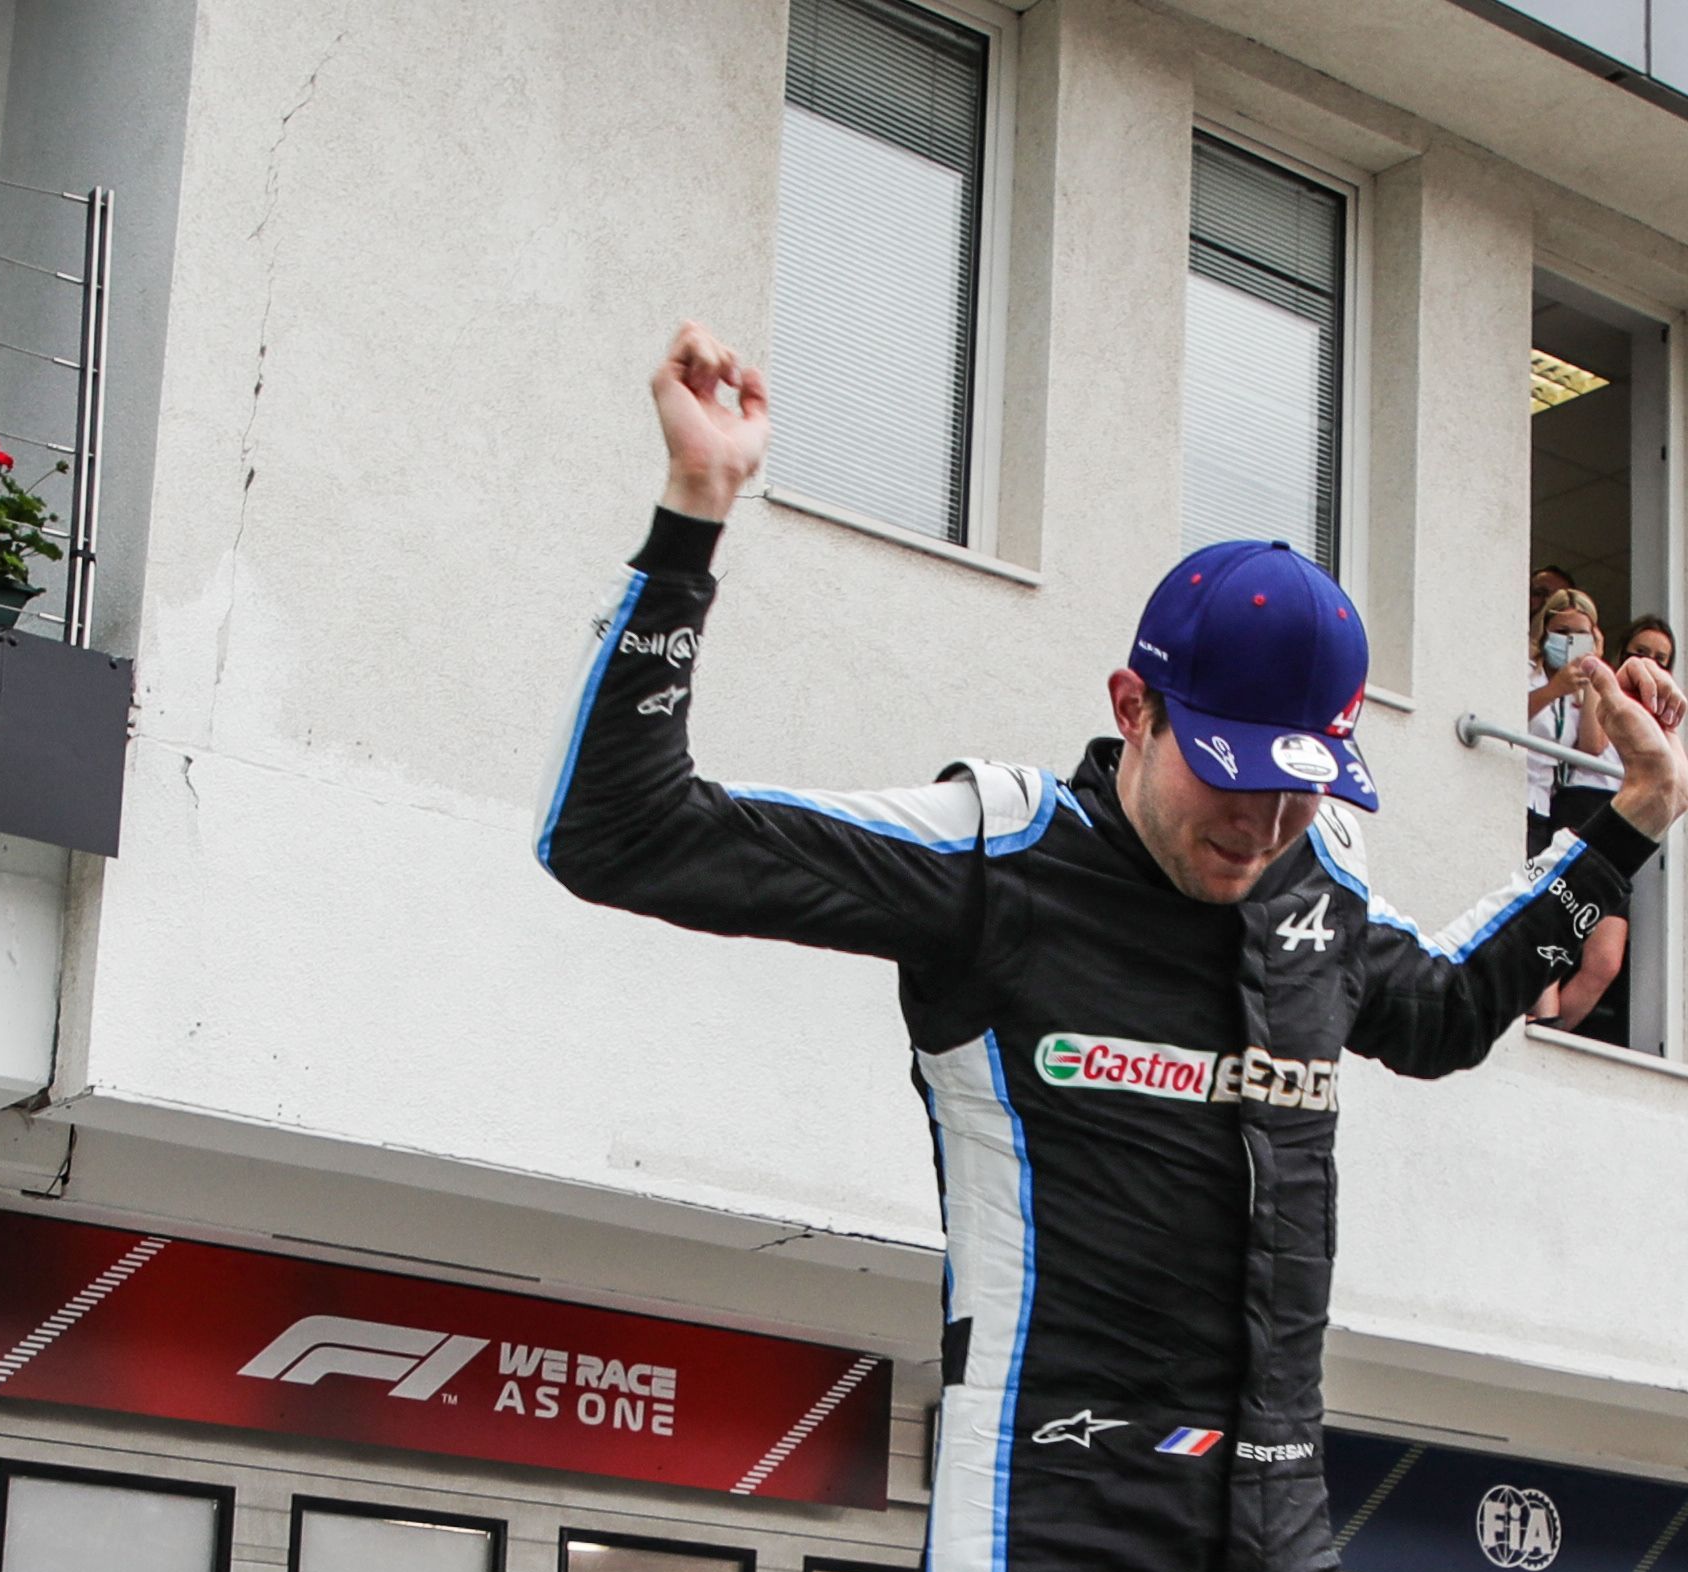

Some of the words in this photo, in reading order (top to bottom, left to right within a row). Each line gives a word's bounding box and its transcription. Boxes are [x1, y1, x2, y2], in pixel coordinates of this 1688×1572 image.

[1548, 877, 1579, 914] Bell
[1083, 1044, 1206, 1095] Castrol
[498, 1342, 569, 1378] WE
[575, 1354, 677, 1400] RACE
[494, 1380, 560, 1419] AS
[577, 1392, 675, 1437] ONE
[1236, 1441, 1315, 1463] ESTEBAN
